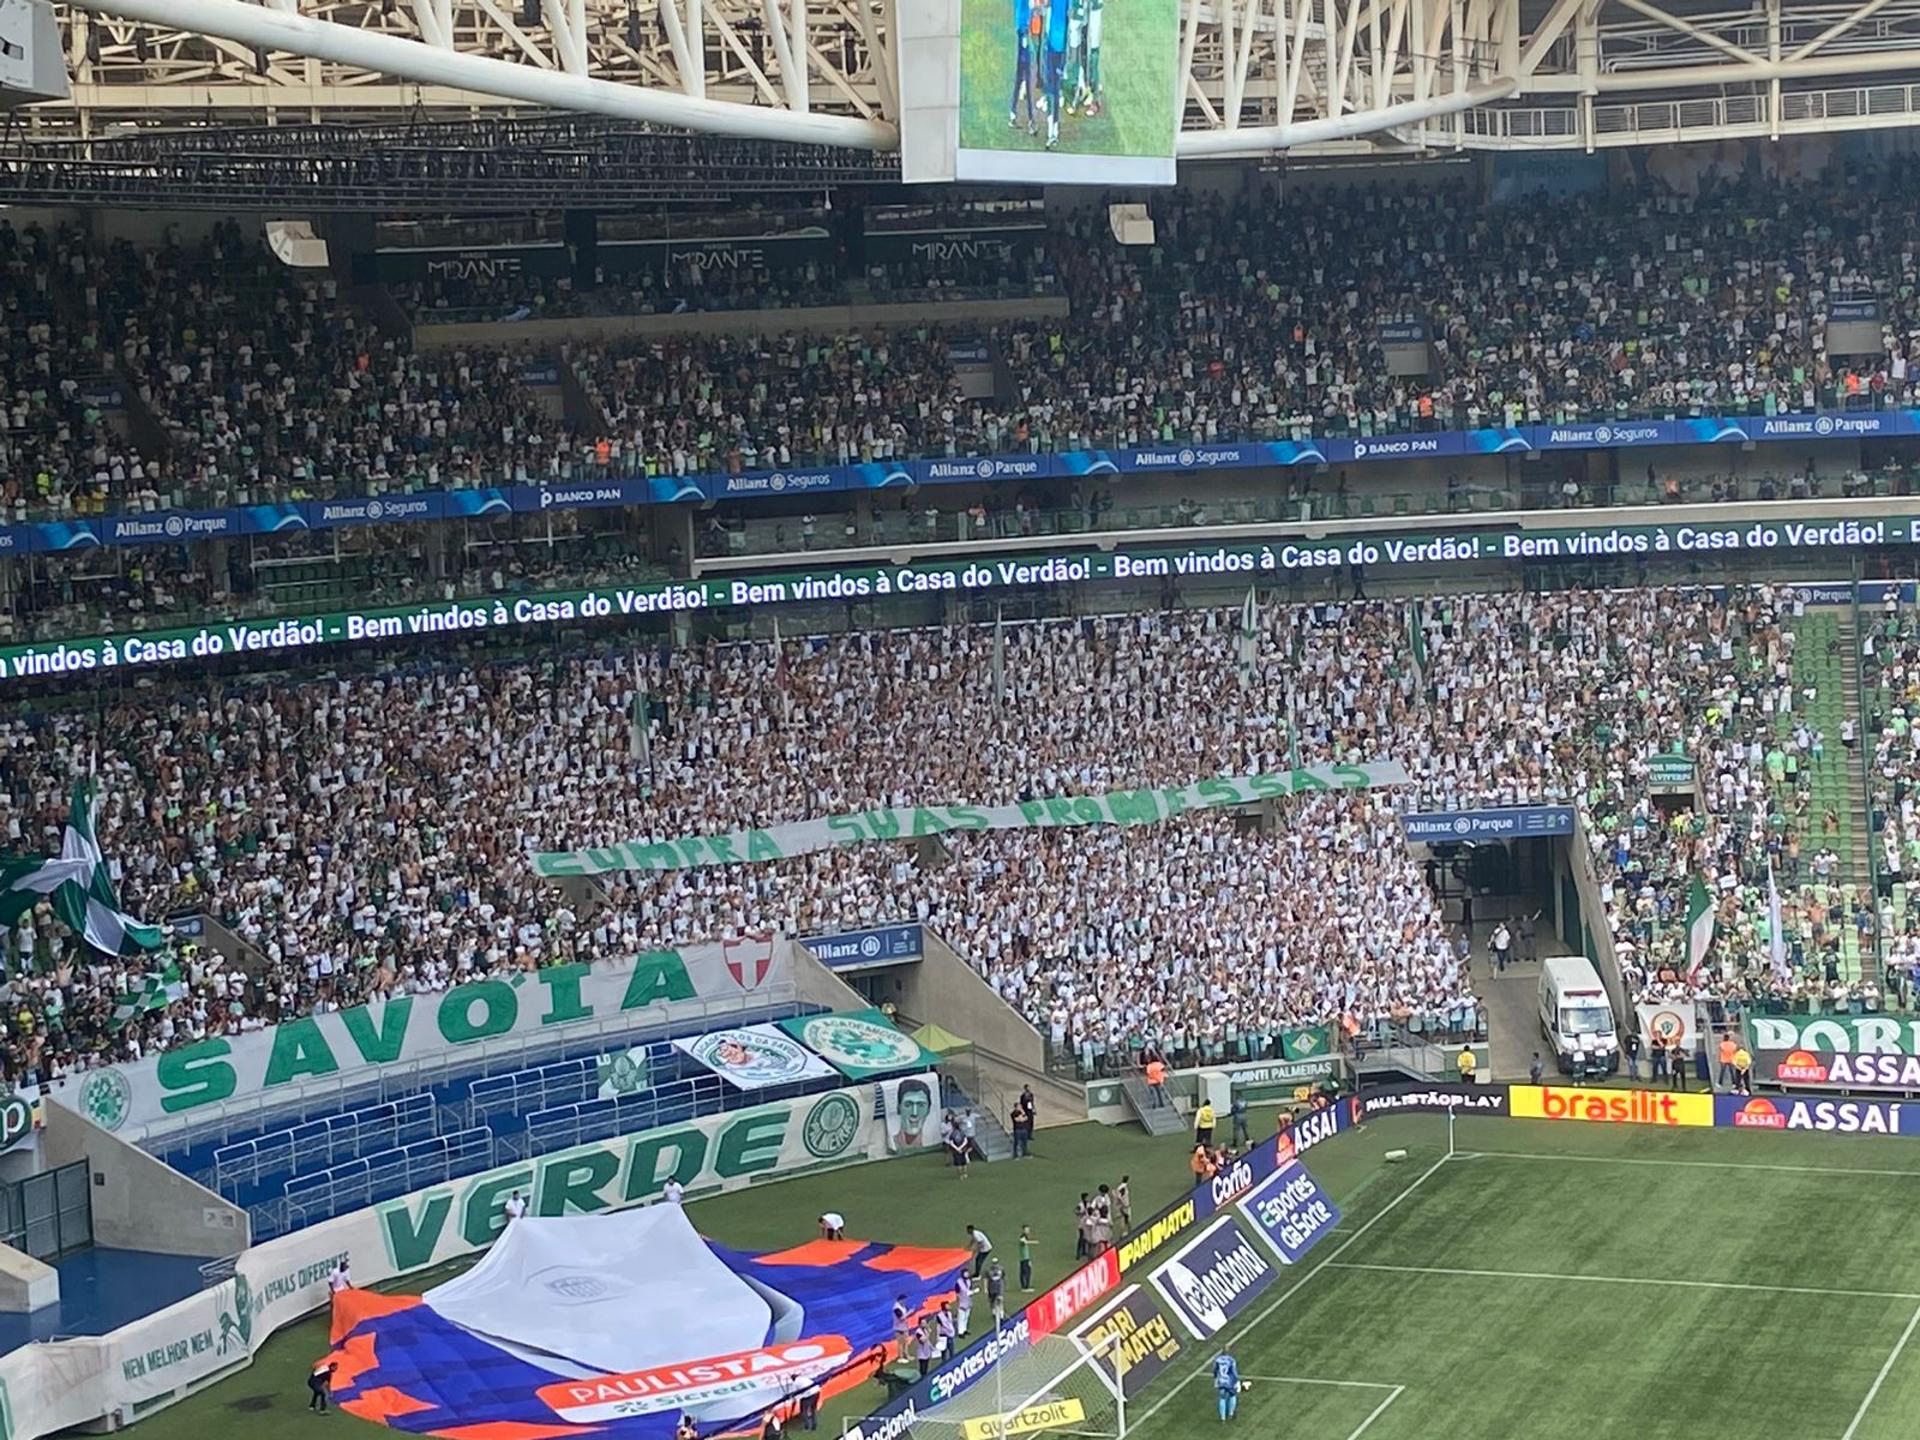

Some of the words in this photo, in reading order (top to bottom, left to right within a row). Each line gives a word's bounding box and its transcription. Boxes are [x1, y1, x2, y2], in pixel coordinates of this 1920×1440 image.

[912, 240, 1002, 260] MIRANT
[1550, 429, 1594, 443] Allianz
[1613, 426, 1659, 442] Seguros
[1764, 419, 1813, 434] Allianz
[1834, 416, 1881, 433] Parque
[1135, 452, 1177, 466] Allianz
[1195, 449, 1240, 465] Seguros
[1369, 442, 1409, 454] BANCO
[1412, 439, 1437, 452] PAN
[929, 463, 975, 478] Allianz
[995, 460, 1037, 476] Parque
[555, 491, 594, 503] BANCO
[596, 488, 622, 500] PAN
[726, 476, 769, 491] Allianz
[786, 474, 830, 489] Seguros
[323, 505, 365, 521] Allianz
[384, 501, 428, 518] Seguros
[116, 521, 163, 537] Allianz
[184, 516, 227, 533] Parque
[13, 645, 97, 676] vindos
[102, 640, 118, 666] à
[124, 638, 186, 664] Casa
[192, 630, 223, 656] do
[228, 618, 324, 651] Verdão!
[347, 615, 403, 640] Bem
[407, 606, 488, 633] vindos
[493, 600, 509, 625] à
[514, 598, 575, 623] Casa
[580, 592, 611, 617] do
[615, 583, 709, 614] Verdão!
[730, 581, 786, 605] Bem
[791, 574, 870, 600] vindos
[875, 570, 891, 593] à
[896, 568, 956, 593] Casa
[962, 562, 993, 588] do
[996, 557, 1092, 585] Verdão!
[1113, 554, 1169, 578] Bem
[1174, 548, 1254, 575] vindos
[1259, 546, 1276, 570] à
[1281, 545, 1342, 568] Casa
[1348, 540, 1380, 565] do
[1384, 536, 1480, 564] Verdão!
[1503, 534, 1560, 558] Bem
[1564, 531, 1648, 555] vindos
[1654, 528, 1671, 552] à
[1676, 527, 1740, 550] Casa
[1745, 524, 1778, 548] do
[1782, 521, 1885, 547] Verdão!
[1812, 587, 1853, 603] Parque
[538, 829, 783, 876] CUMPRA
[827, 804, 988, 843] SUAS
[1019, 764, 1371, 827] PROMESSAS
[1407, 820, 1452, 834] Allianz
[1472, 817, 1514, 832] Parque
[1271, 1062, 1333, 1079] PALMEIRAS
[1543, 1084, 1679, 1127] brasilit
[1787, 1101, 1902, 1134] ASSAÍ
[1294, 1103, 1338, 1156] ASSAÍ
[376, 1104, 792, 1272] VERDE
[1257, 1173, 1317, 1229] Esportes
[1290, 1200, 1333, 1239] Sorte
[1280, 1224, 1306, 1250] da
[264, 1273, 296, 1305] APENAS
[1053, 1257, 1109, 1324] BETANO
[121, 1355, 146, 1381] NEM
[146, 1339, 190, 1372] MELHOR
[568, 1344, 826, 1403] PAULISTÃO
[930, 1350, 986, 1402] Esportes
[654, 1379, 757, 1406] Sicredi
